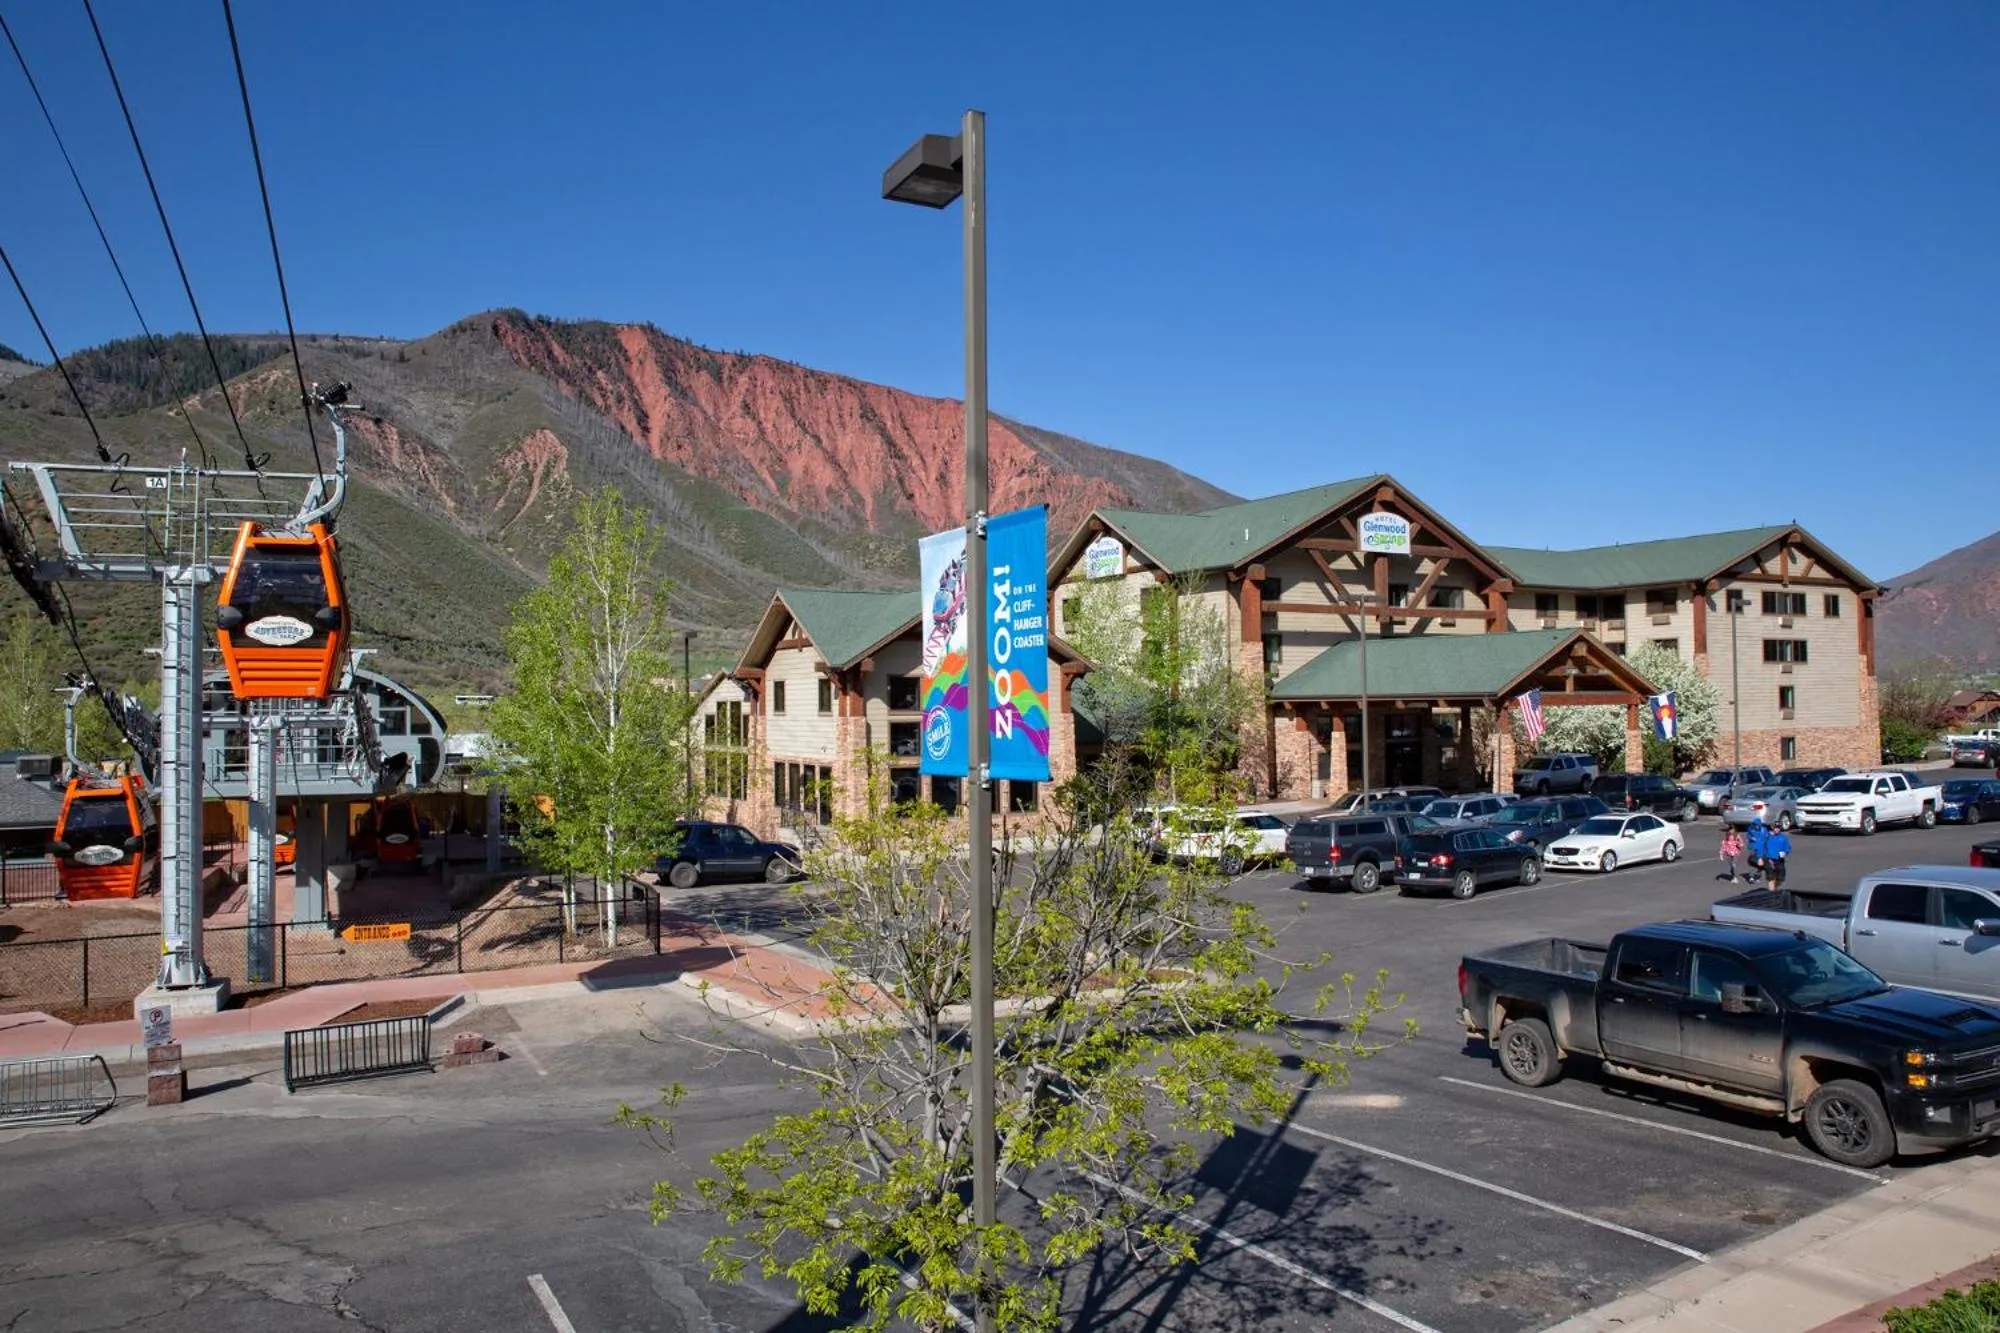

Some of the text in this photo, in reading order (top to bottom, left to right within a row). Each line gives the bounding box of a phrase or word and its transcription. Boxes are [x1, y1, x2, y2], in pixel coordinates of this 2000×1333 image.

[150, 478, 164, 487] 1A
[1364, 521, 1406, 533] Glenwood
[1013, 583, 1037, 595] ON THE
[1013, 599, 1035, 613] CLIFF-
[1014, 616, 1042, 631] HANGER
[1014, 634, 1044, 649] COASTER
[993, 564, 1013, 740] ZOOM!
[354, 926, 390, 941] ENTRANCE
